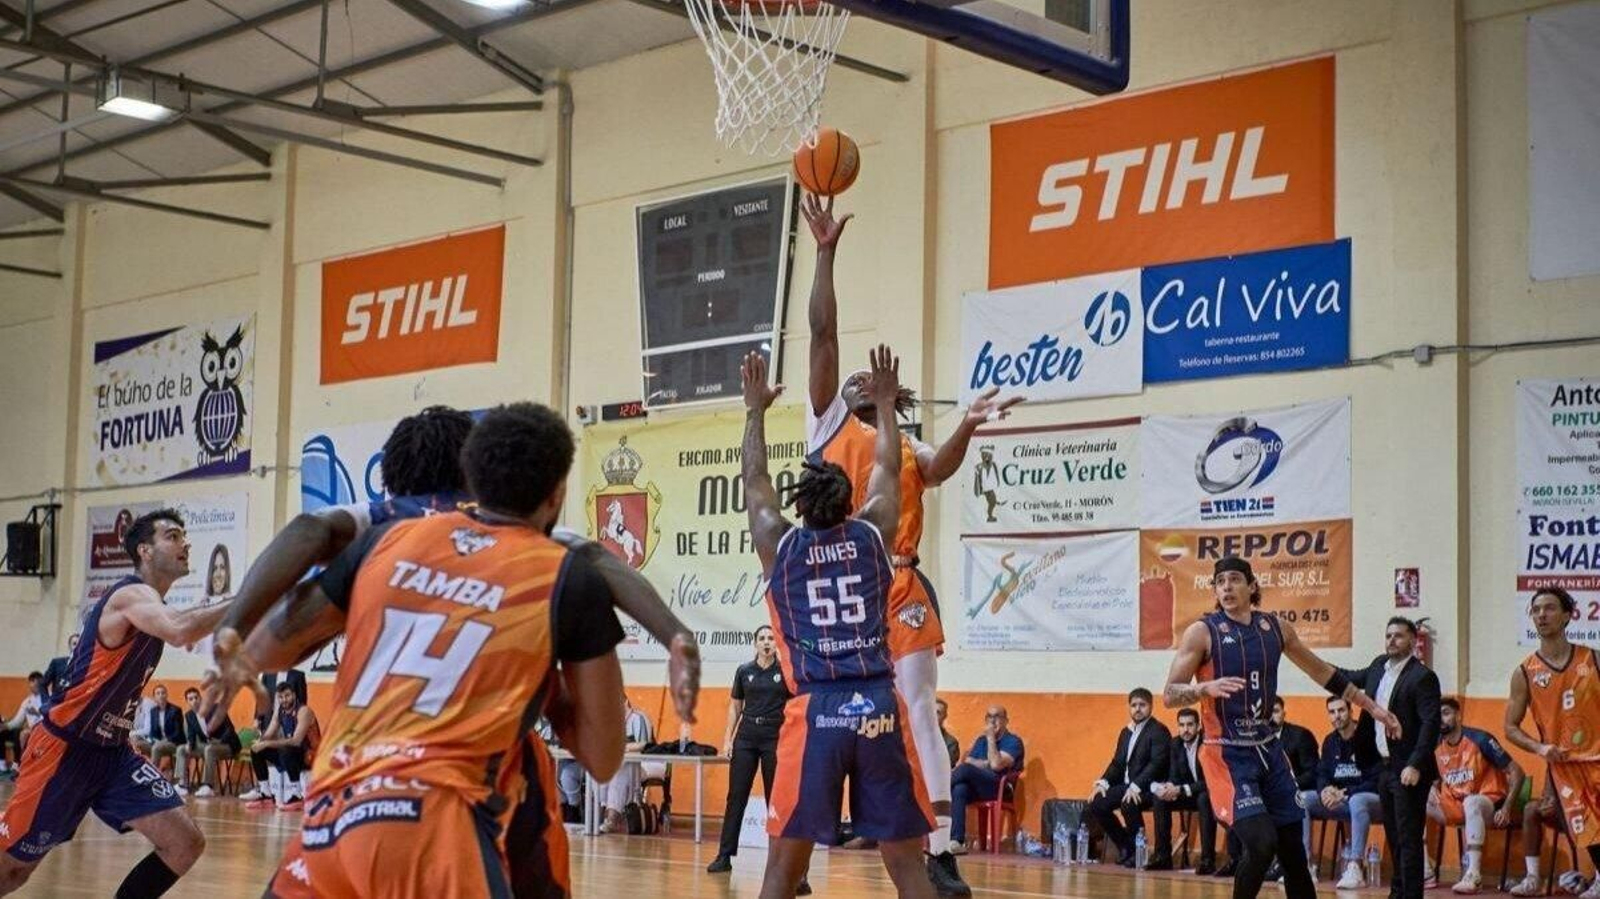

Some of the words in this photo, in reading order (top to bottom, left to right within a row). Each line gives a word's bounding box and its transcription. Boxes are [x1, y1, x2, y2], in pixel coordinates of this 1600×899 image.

[1030, 126, 1288, 234] STIHL
[664, 215, 687, 230] LOCAL
[733, 200, 768, 216] VISITANTE
[340, 273, 478, 345] STIHL
[1146, 277, 1225, 334] Cal
[1241, 270, 1341, 323] Viva
[1204, 337, 1233, 347] taberna
[1235, 332, 1280, 343] restaurante
[970, 334, 1084, 390] besten
[1179, 355, 1211, 369] Teléfono
[1212, 355, 1222, 365] de
[1223, 352, 1259, 365] Reservas:
[97, 384, 110, 410] El
[114, 380, 152, 406] búho
[156, 375, 176, 401] de
[180, 372, 193, 397] la
[100, 404, 185, 452] FORTUNA
[1012, 442, 1051, 459] Clínica
[1055, 437, 1118, 456] Veterinaria
[1001, 463, 1056, 487] Cruz
[1062, 457, 1128, 483] Verde
[1079, 496, 1114, 508] MORÓN
[1213, 498, 1246, 512] TIEN
[1532, 485, 1553, 497] 660
[1557, 485, 1578, 496] 162
[676, 531, 698, 556] DE
[708, 530, 730, 555] LA
[805, 540, 858, 566] JONES
[1197, 530, 1330, 560] REPSOL
[389, 560, 506, 612] TAMBA
[721, 572, 748, 605] el
[1307, 569, 1330, 586] S.L.
[806, 574, 866, 626] 55
[1302, 609, 1330, 622] 475
[347, 607, 494, 718] 14
[1250, 671, 1260, 690] 9
[1561, 689, 1576, 710] 6
[1570, 814, 1584, 834] 6
